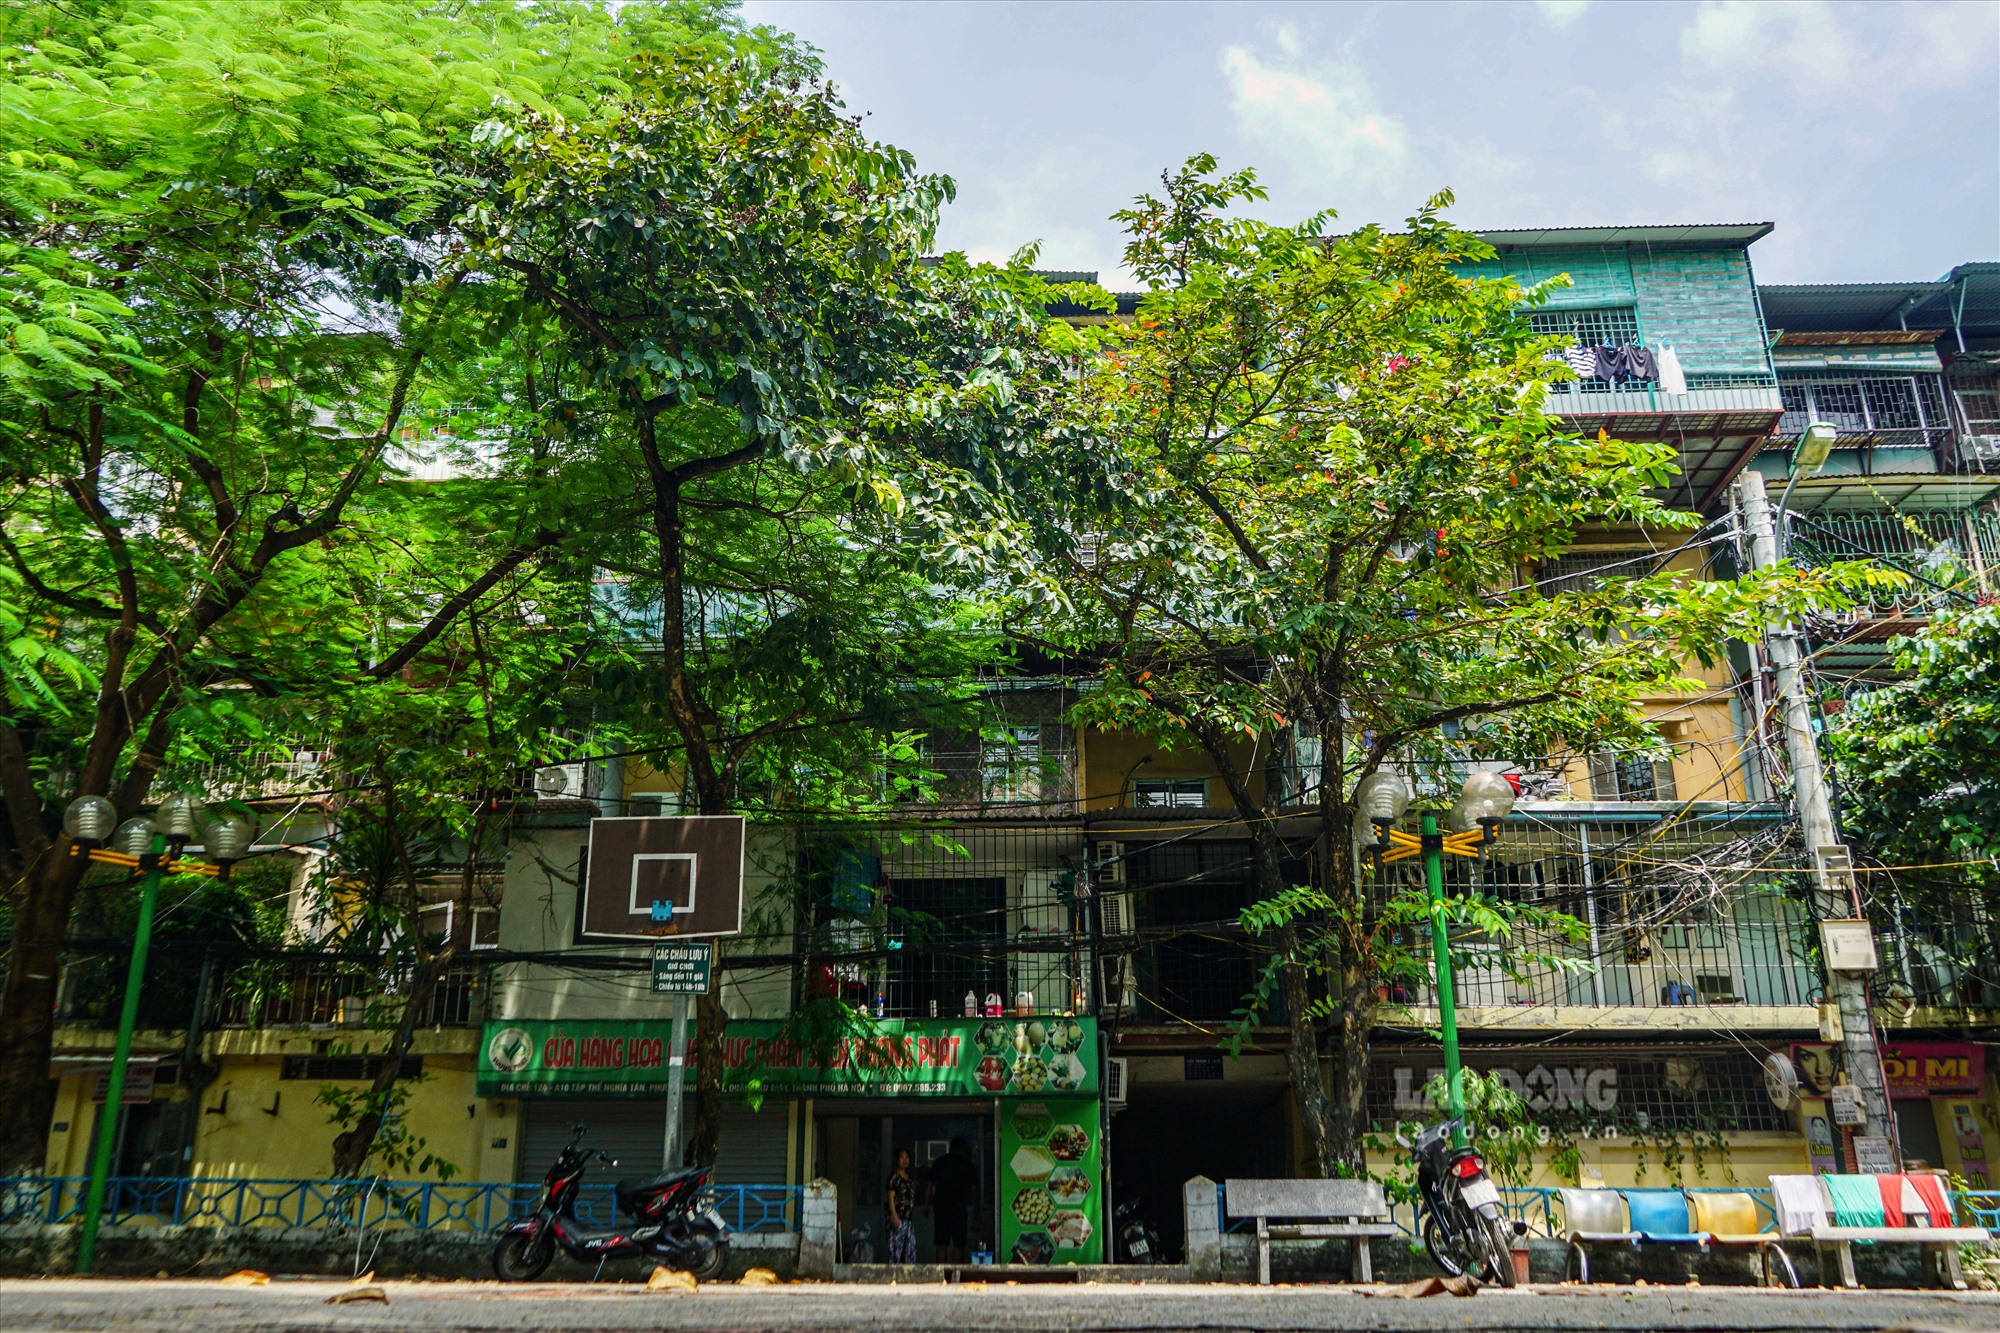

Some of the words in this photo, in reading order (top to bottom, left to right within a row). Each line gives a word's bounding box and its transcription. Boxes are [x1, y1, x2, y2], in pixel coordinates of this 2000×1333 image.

[656, 947, 669, 960] CÁC
[670, 947, 688, 960] CHÁU
[543, 1029, 575, 1068] CỬA
[579, 1031, 624, 1068] HÀNG
[628, 1038, 663, 1068] HOA
[917, 1029, 961, 1069] PHÁT
[1882, 1050, 1917, 1077] ỐI
[1925, 1058, 1969, 1077] MI
